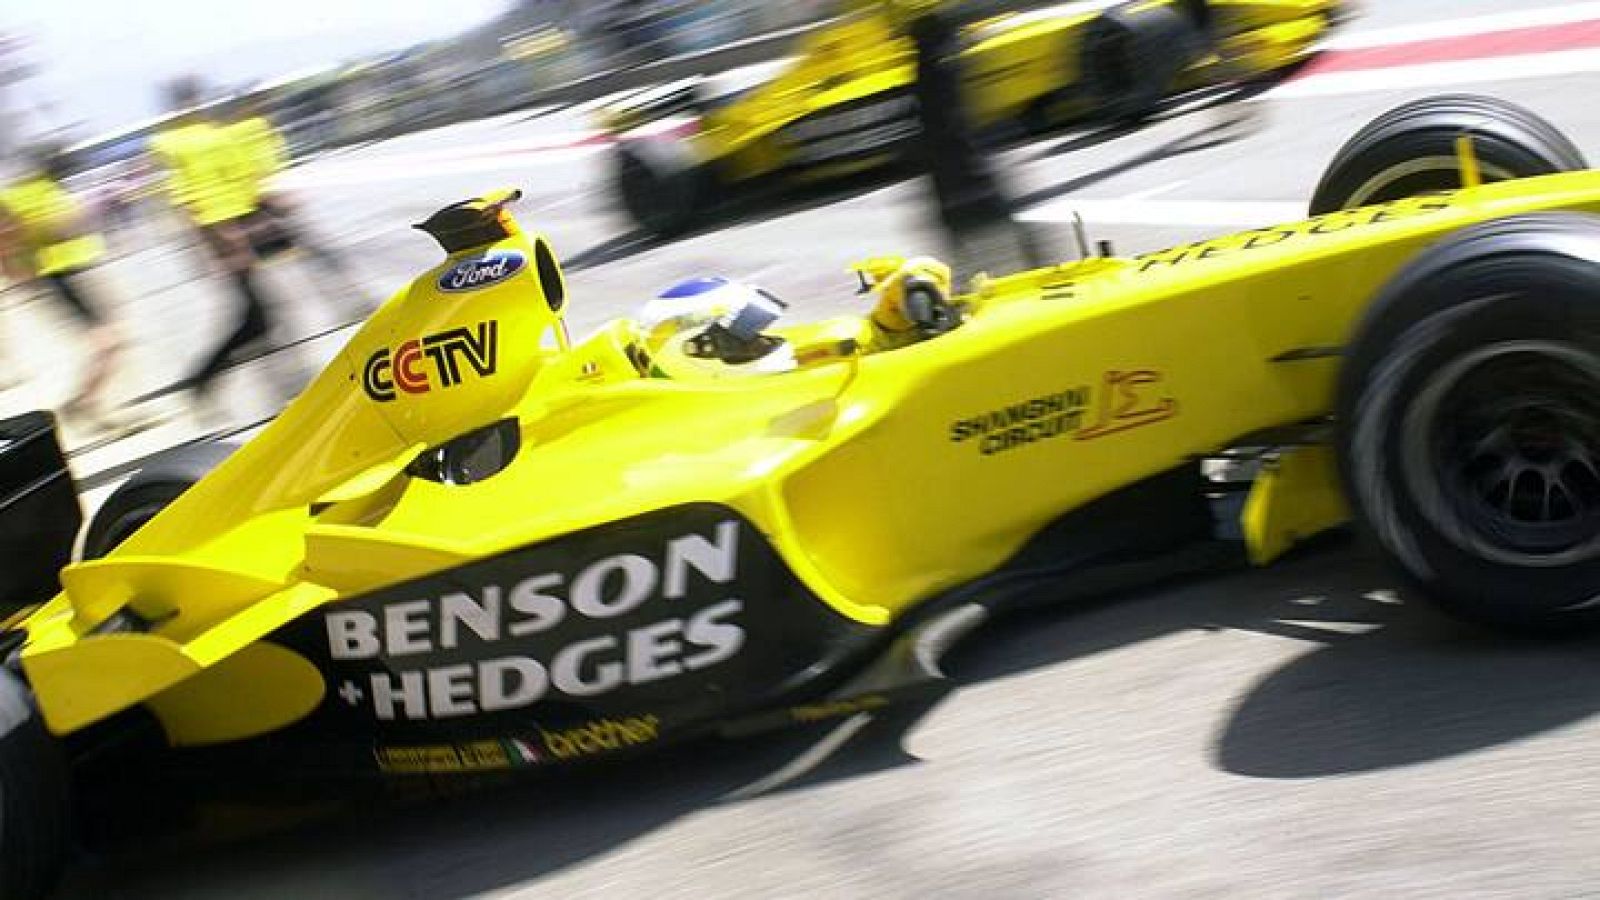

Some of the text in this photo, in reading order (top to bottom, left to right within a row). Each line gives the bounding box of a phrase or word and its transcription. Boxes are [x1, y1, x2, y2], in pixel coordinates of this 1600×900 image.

[451, 257, 507, 288] Ford
[363, 320, 497, 402] CCTV
[950, 386, 1091, 441] SHANGHAI
[979, 408, 1085, 455] CIRCUIT
[326, 520, 740, 660] BENSON
